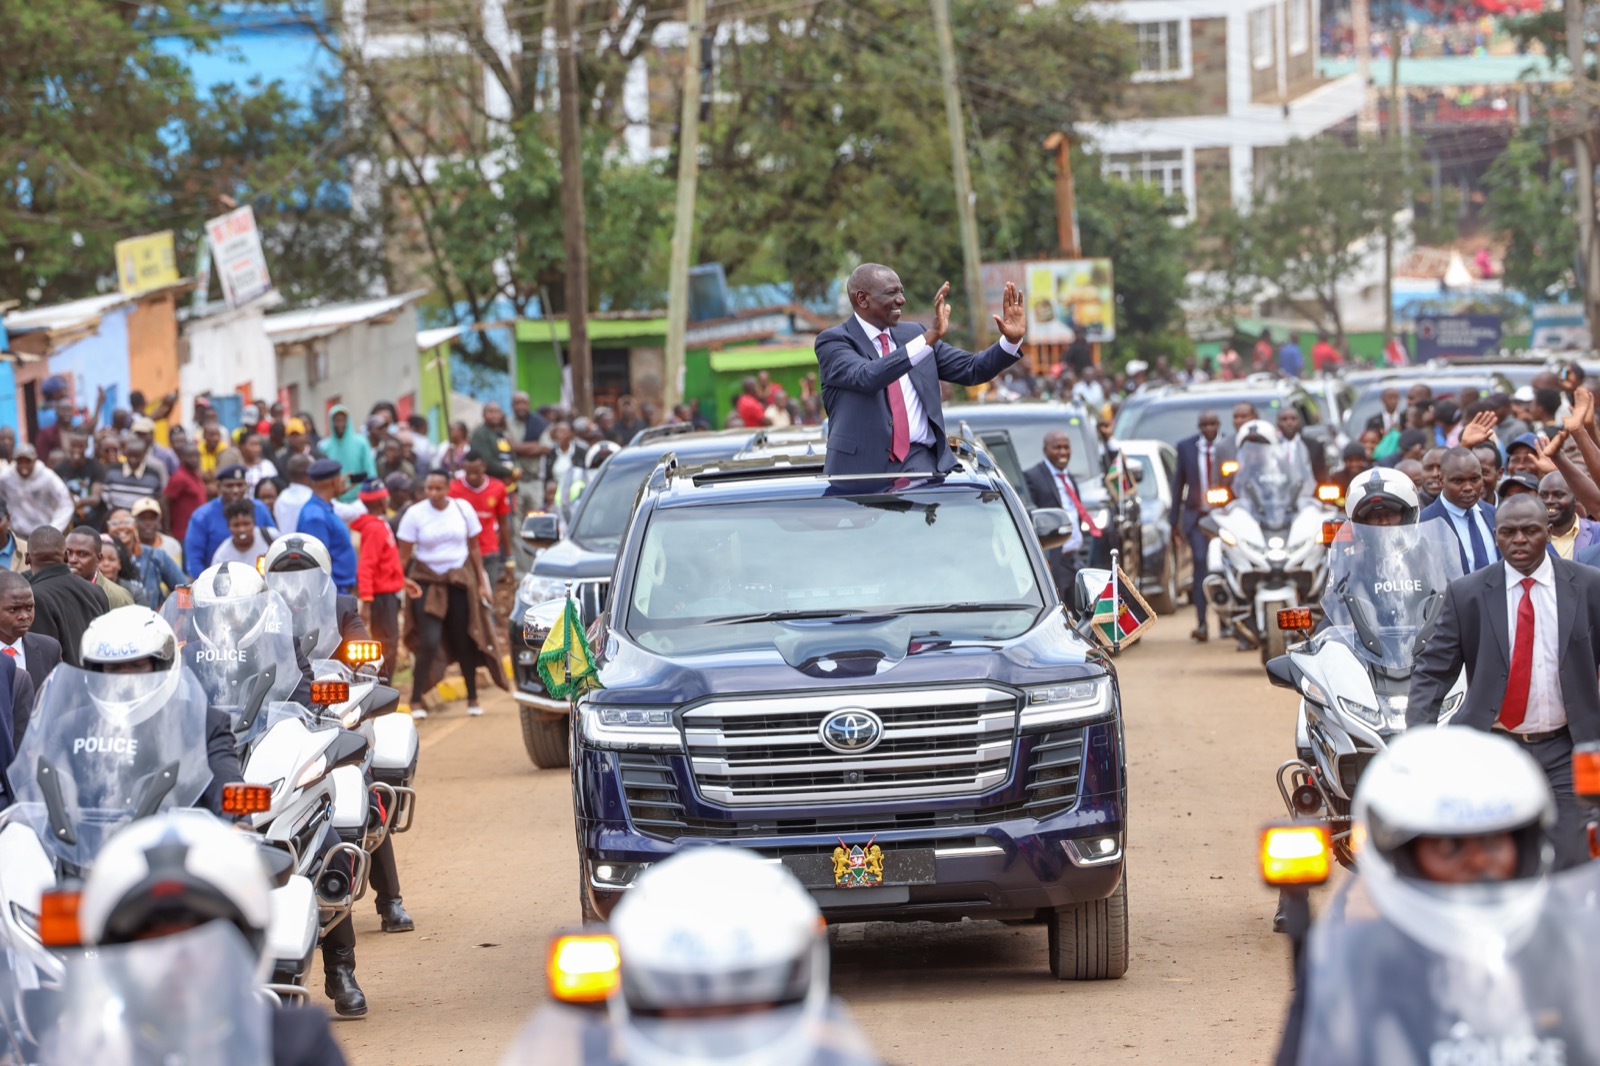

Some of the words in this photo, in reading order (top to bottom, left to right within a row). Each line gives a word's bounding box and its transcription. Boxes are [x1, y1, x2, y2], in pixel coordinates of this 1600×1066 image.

[1374, 580, 1422, 594] POLICE
[264, 621, 282, 633] ICE
[97, 642, 137, 657] POLICE
[196, 650, 247, 663] POLICE
[73, 737, 137, 755] POLICE
